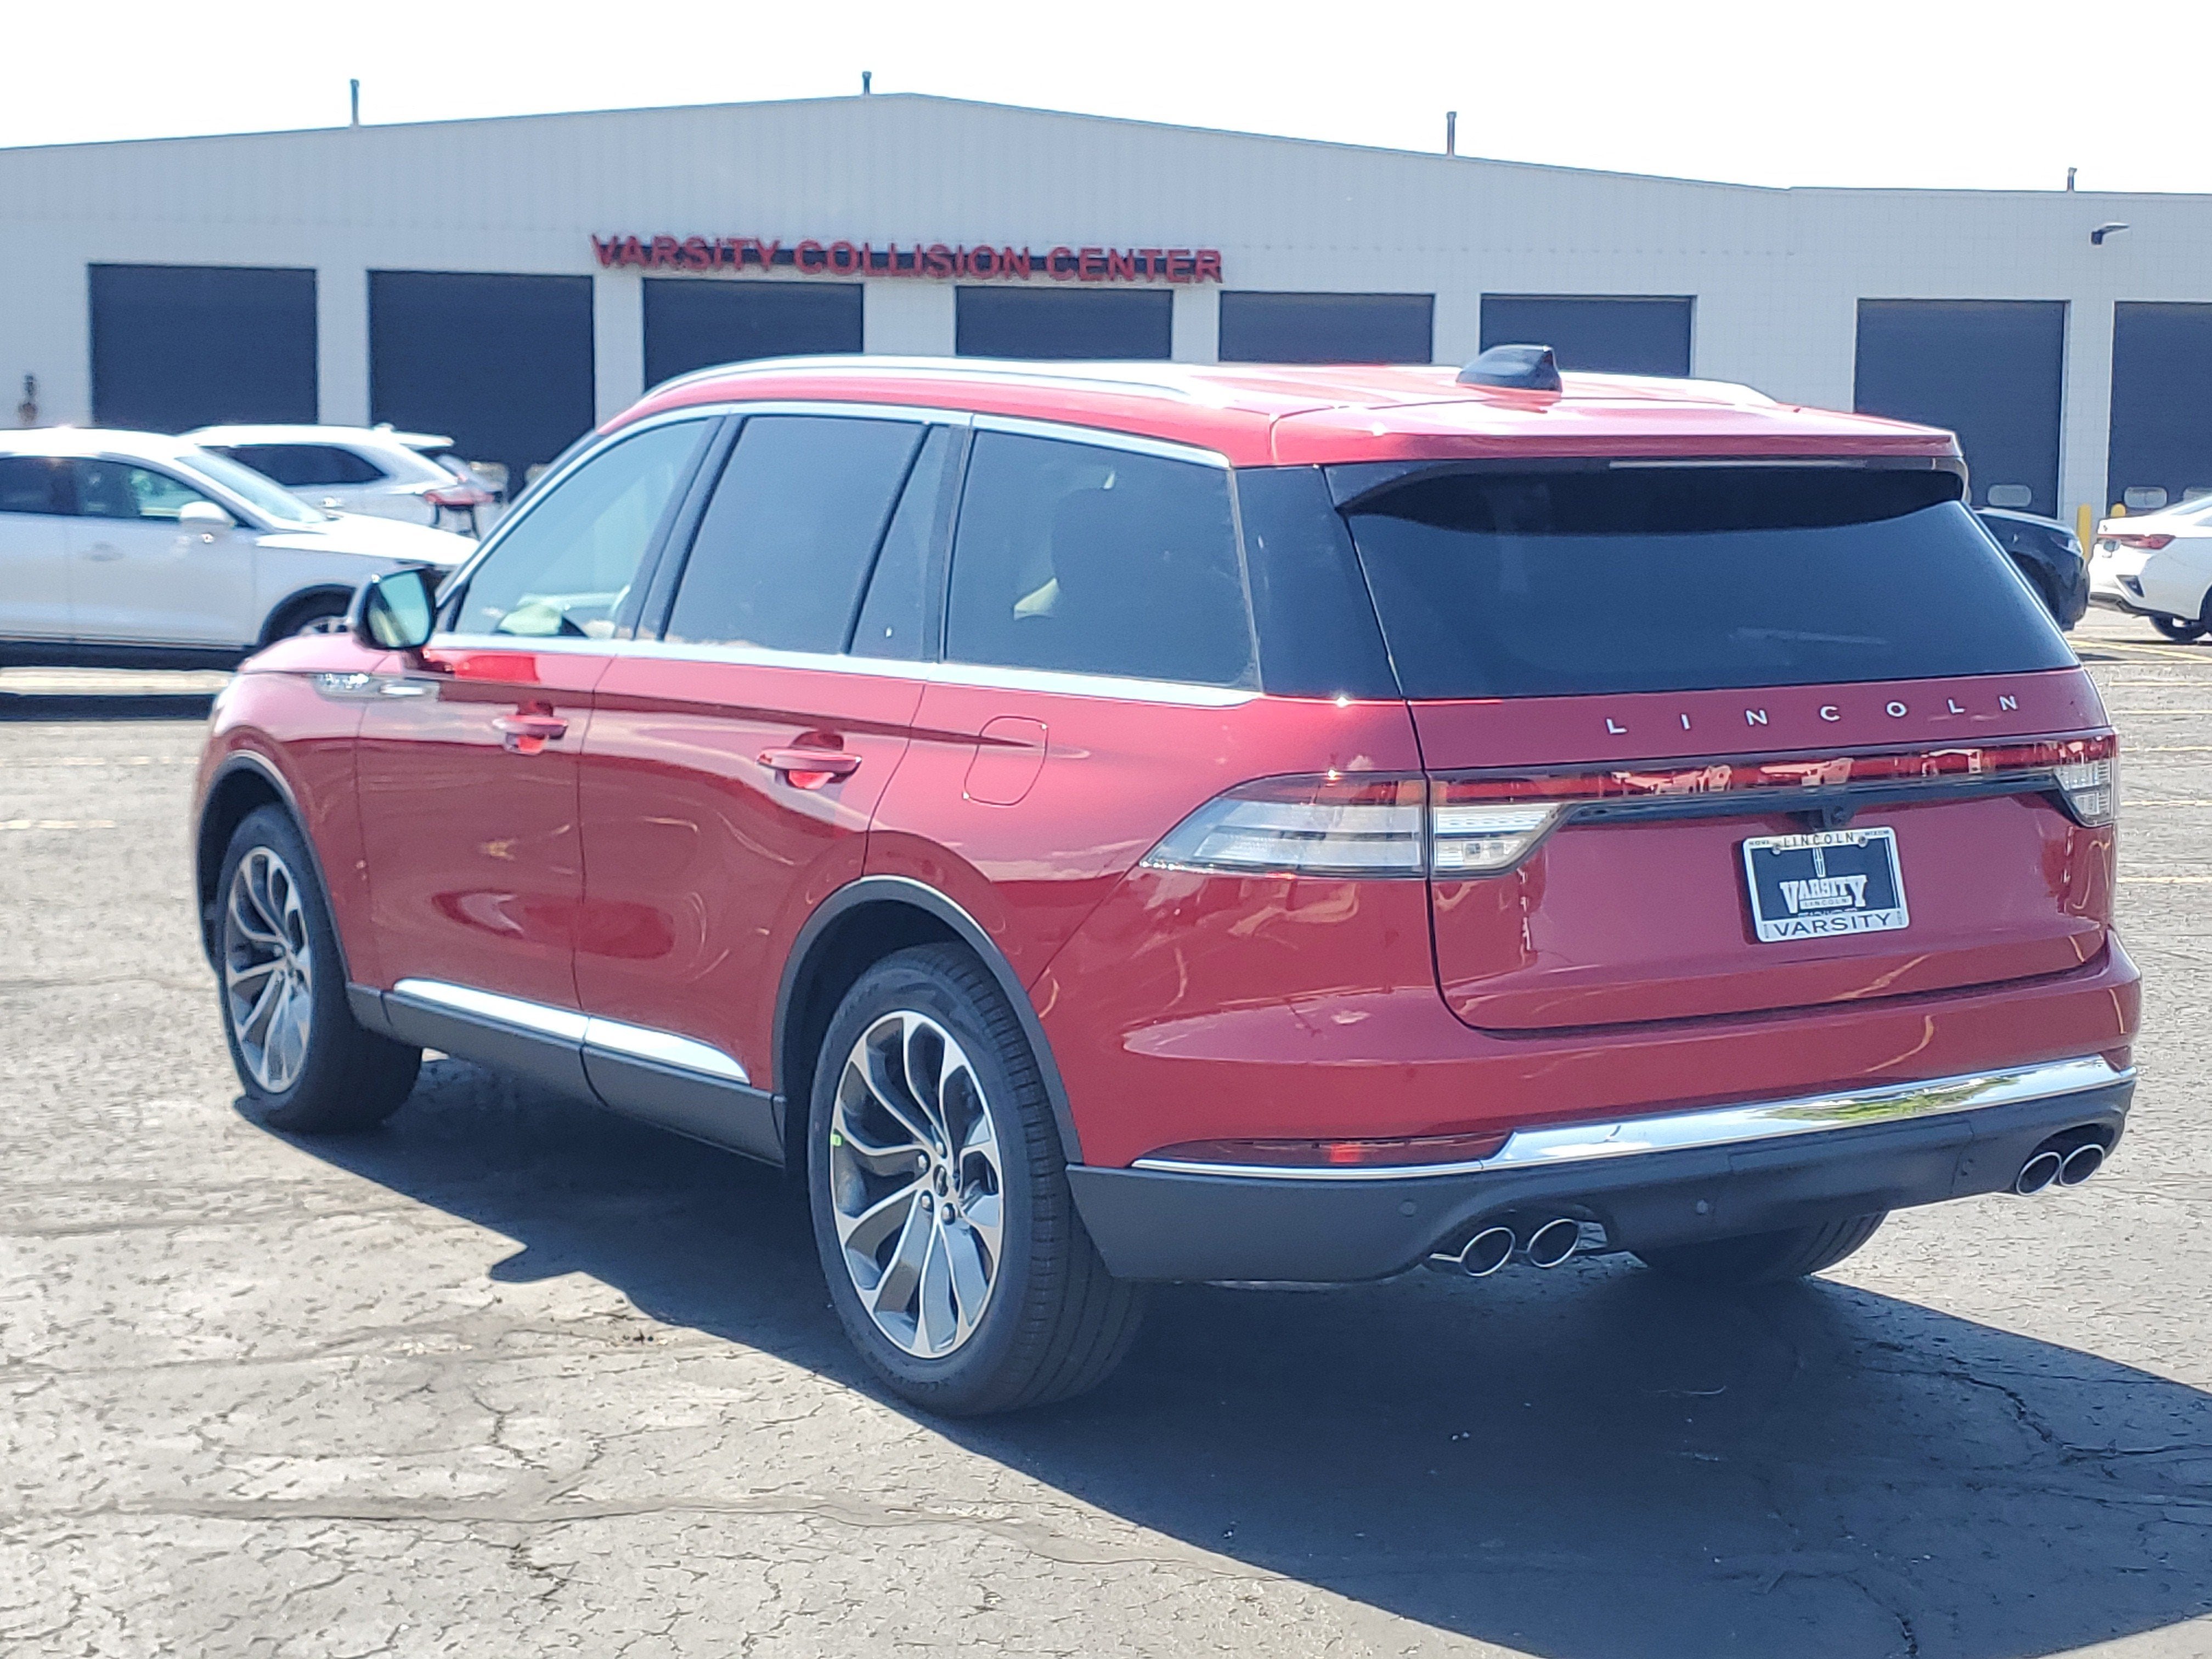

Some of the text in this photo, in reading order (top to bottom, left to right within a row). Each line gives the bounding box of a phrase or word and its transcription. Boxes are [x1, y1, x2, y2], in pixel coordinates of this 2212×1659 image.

[592, 234, 1222, 284] VARSITY COLLISION CENTER
[1605, 695, 2019, 735] LINCOLN
[1784, 832, 1854, 847] LINCOLN
[1779, 874, 1867, 913] VARSITY
[1774, 913, 1891, 936] VARSITY
